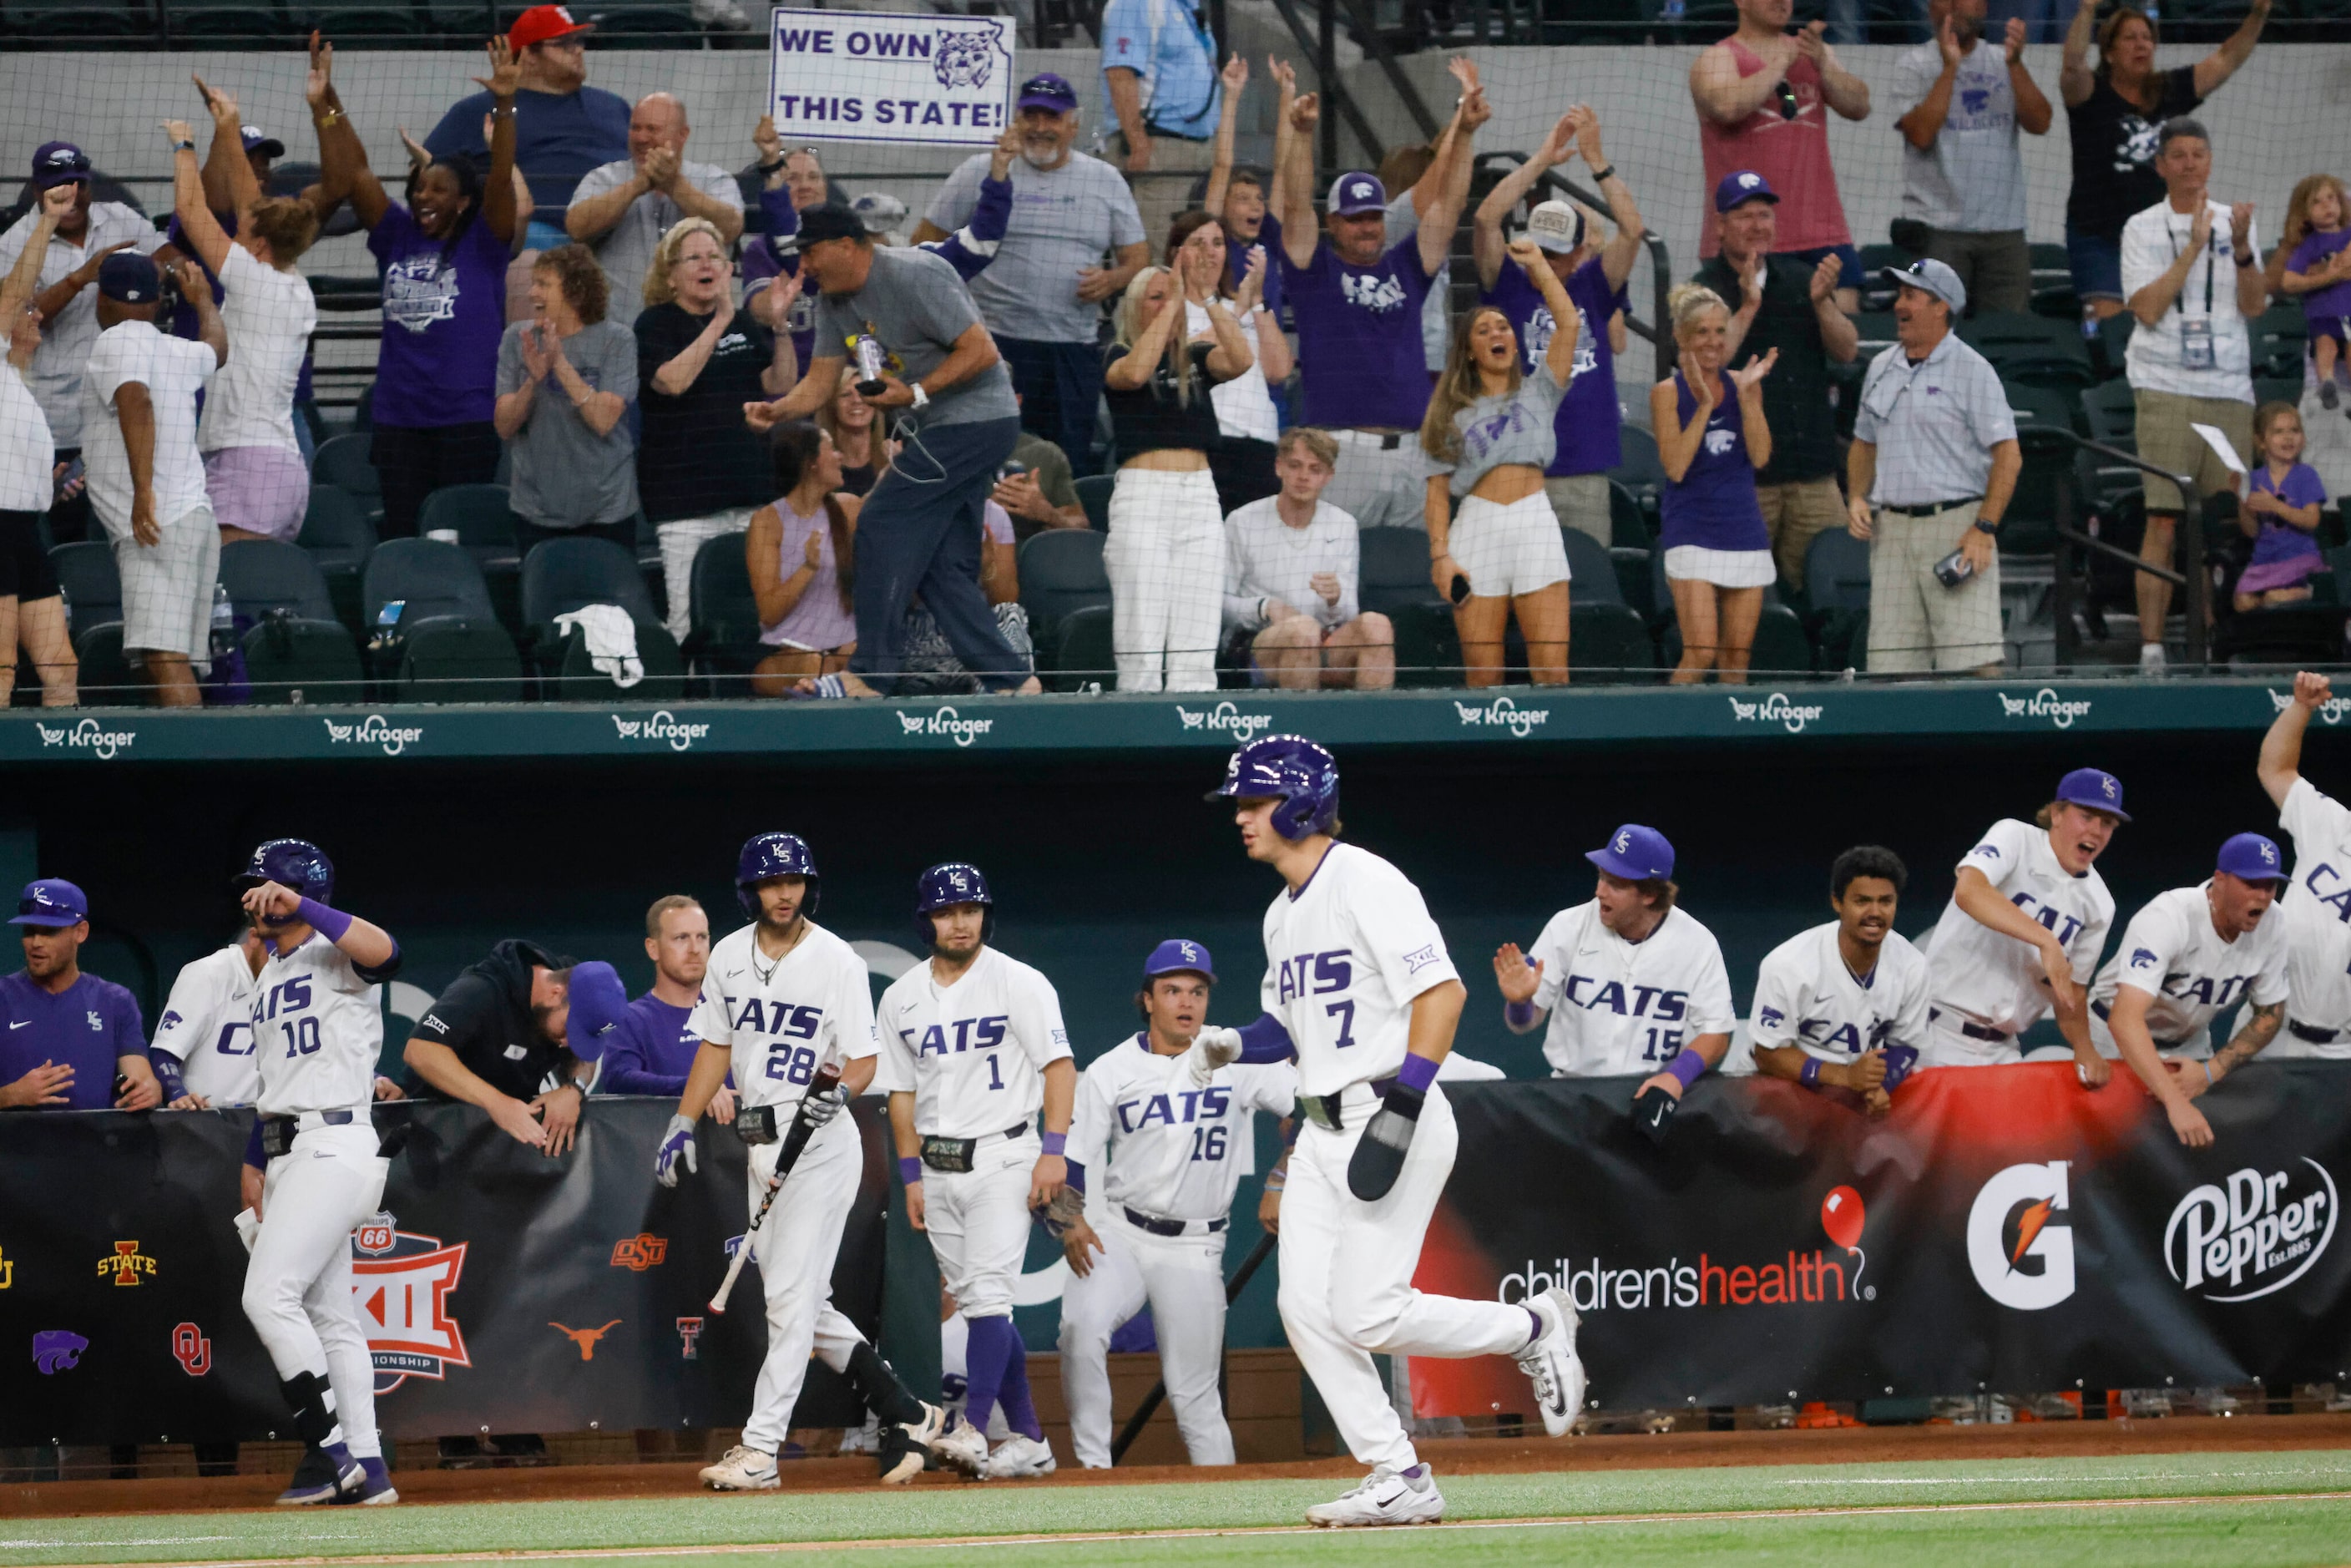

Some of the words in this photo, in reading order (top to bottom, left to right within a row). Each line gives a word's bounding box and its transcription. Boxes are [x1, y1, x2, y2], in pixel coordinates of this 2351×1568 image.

[780, 28, 834, 53] WE
[847, 32, 931, 57] OWN
[779, 95, 863, 122] THIS
[875, 99, 1002, 127] STATE!
[928, 706, 993, 746] Kroger
[1207, 701, 1272, 741] Kroger
[1485, 696, 1549, 737] Kroger
[1760, 693, 1823, 732] Kroger
[2029, 688, 2091, 729] Kroger
[68, 718, 136, 760] Kroger
[356, 715, 423, 756] Kroger
[644, 711, 709, 751] Kroger
[1280, 948, 1352, 1005] ATS
[250, 973, 312, 1024] ATS
[1566, 974, 1689, 1021] CATS
[281, 1016, 321, 1059] 10
[1326, 999, 1355, 1049] 7
[1642, 1027, 1684, 1062] 15
[766, 1044, 816, 1086] 28
[986, 1054, 1004, 1090] 1
[1118, 1086, 1232, 1134] CATS
[1191, 1125, 1227, 1161] 16
[2227, 1168, 2288, 1232] Dr
[363, 1229, 387, 1246] 66
[610, 1232, 668, 1272] OSU
[1967, 1161, 2075, 1311] G
[2184, 1183, 2326, 1290] Pepper
[97, 1255, 157, 1277] STATE
[173, 1322, 211, 1376] OU
